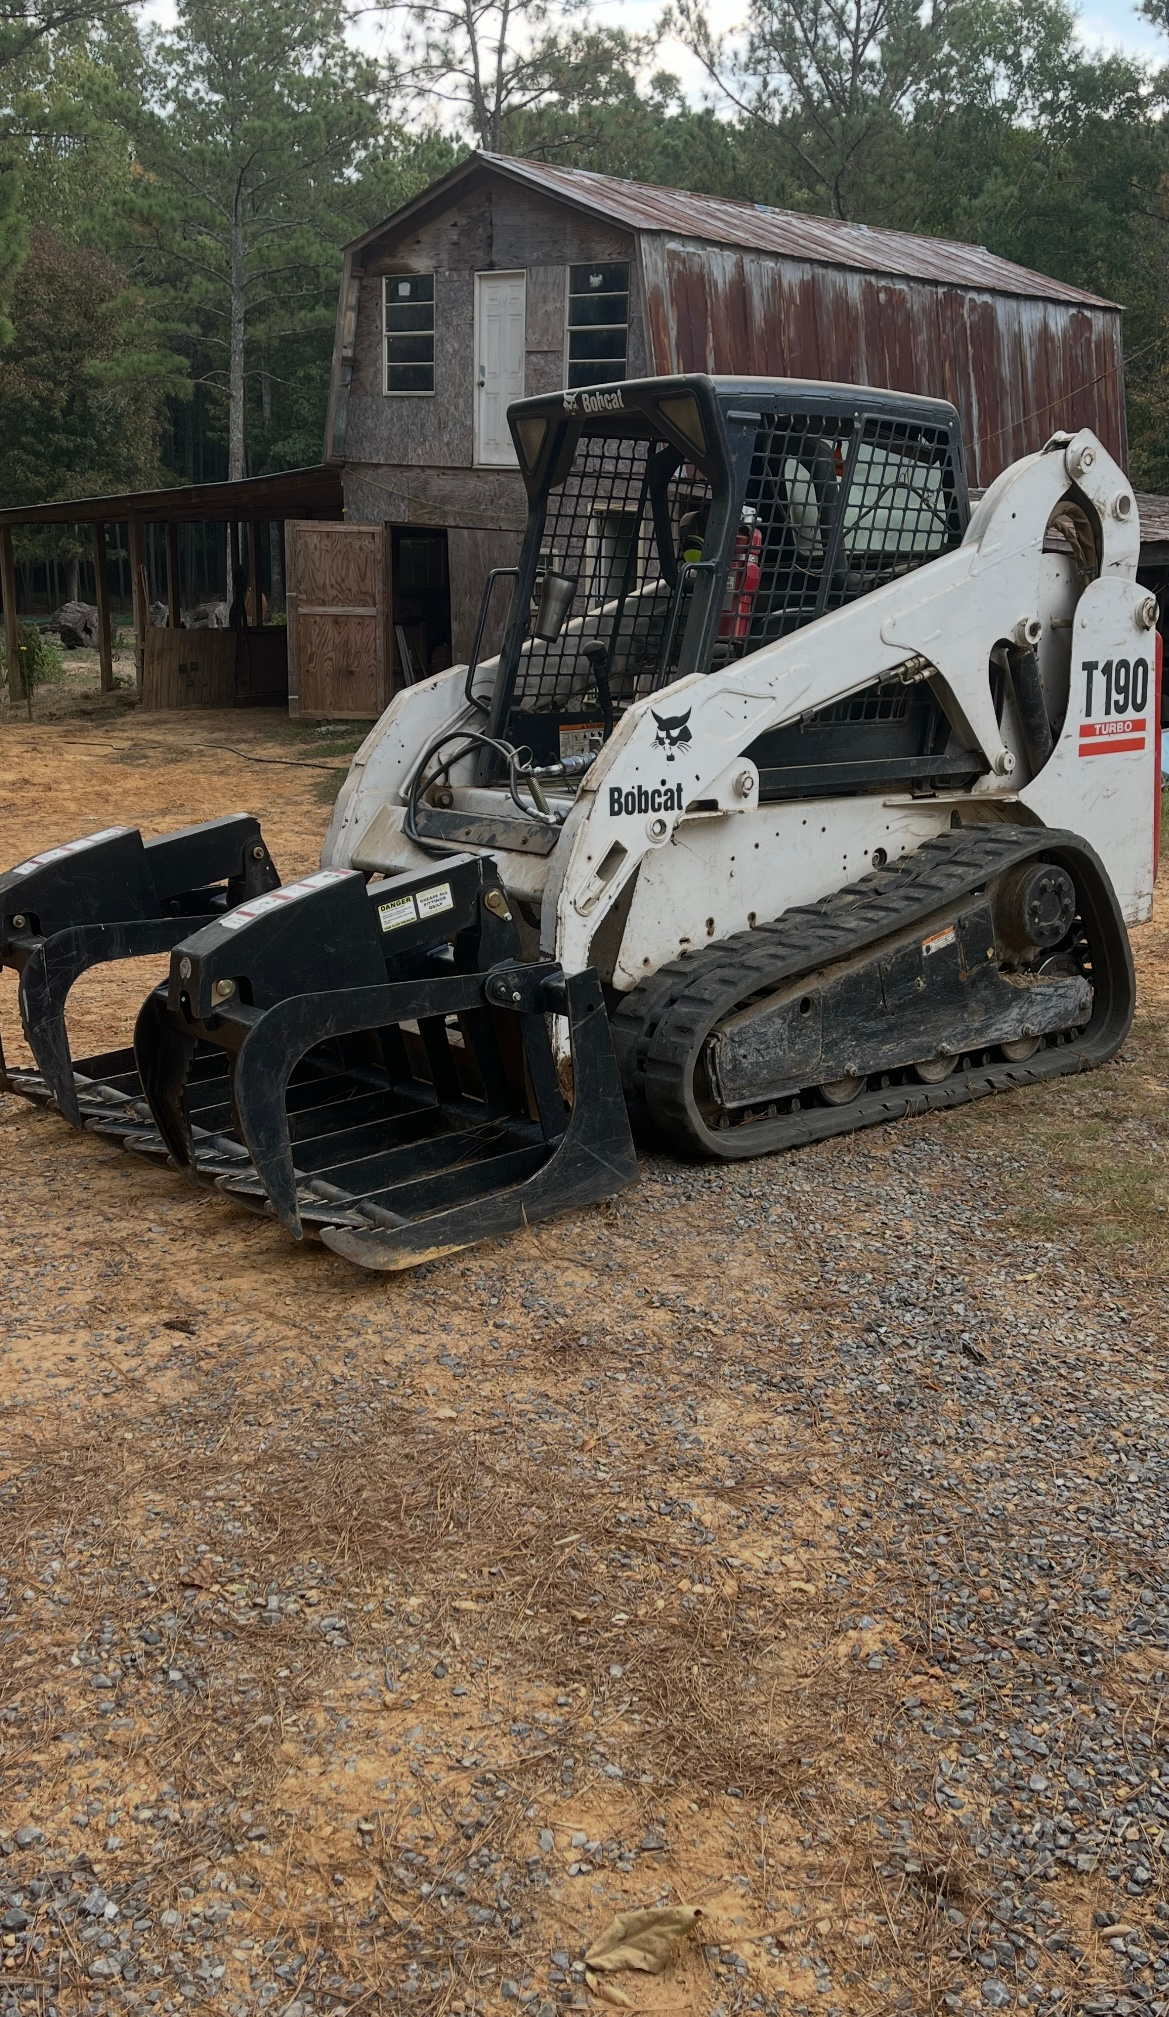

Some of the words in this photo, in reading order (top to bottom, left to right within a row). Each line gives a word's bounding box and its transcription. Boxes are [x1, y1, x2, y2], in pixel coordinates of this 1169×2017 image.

[582, 389, 624, 412] Bobcat
[1082, 657, 1149, 718] T190
[1095, 722, 1132, 735] TURBO
[609, 783, 683, 816] Bobcat
[380, 896, 411, 912] DANGER
[420, 894, 438, 903] GREASE
[428, 902, 443, 910] DAILY
